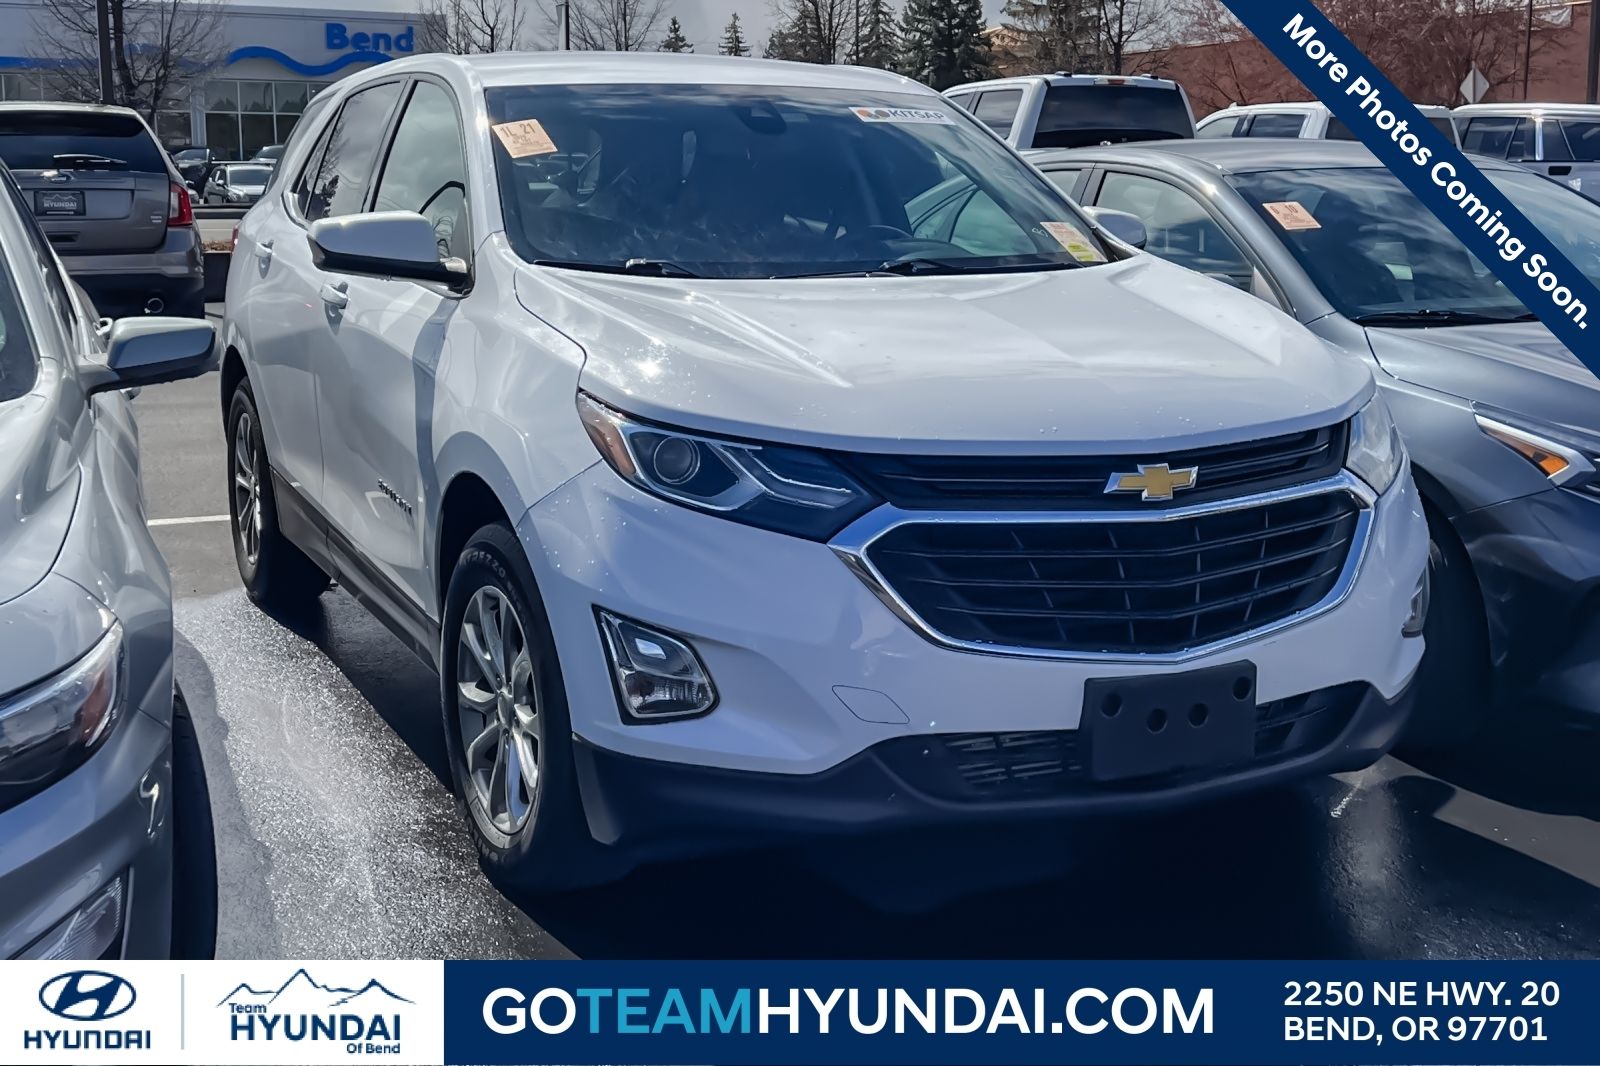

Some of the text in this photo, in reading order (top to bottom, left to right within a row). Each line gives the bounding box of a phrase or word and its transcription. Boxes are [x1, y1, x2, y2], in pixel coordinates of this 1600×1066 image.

[325, 22, 414, 52] Bend
[887, 109, 945, 119] KITSAP
[519, 122, 536, 135] 21
